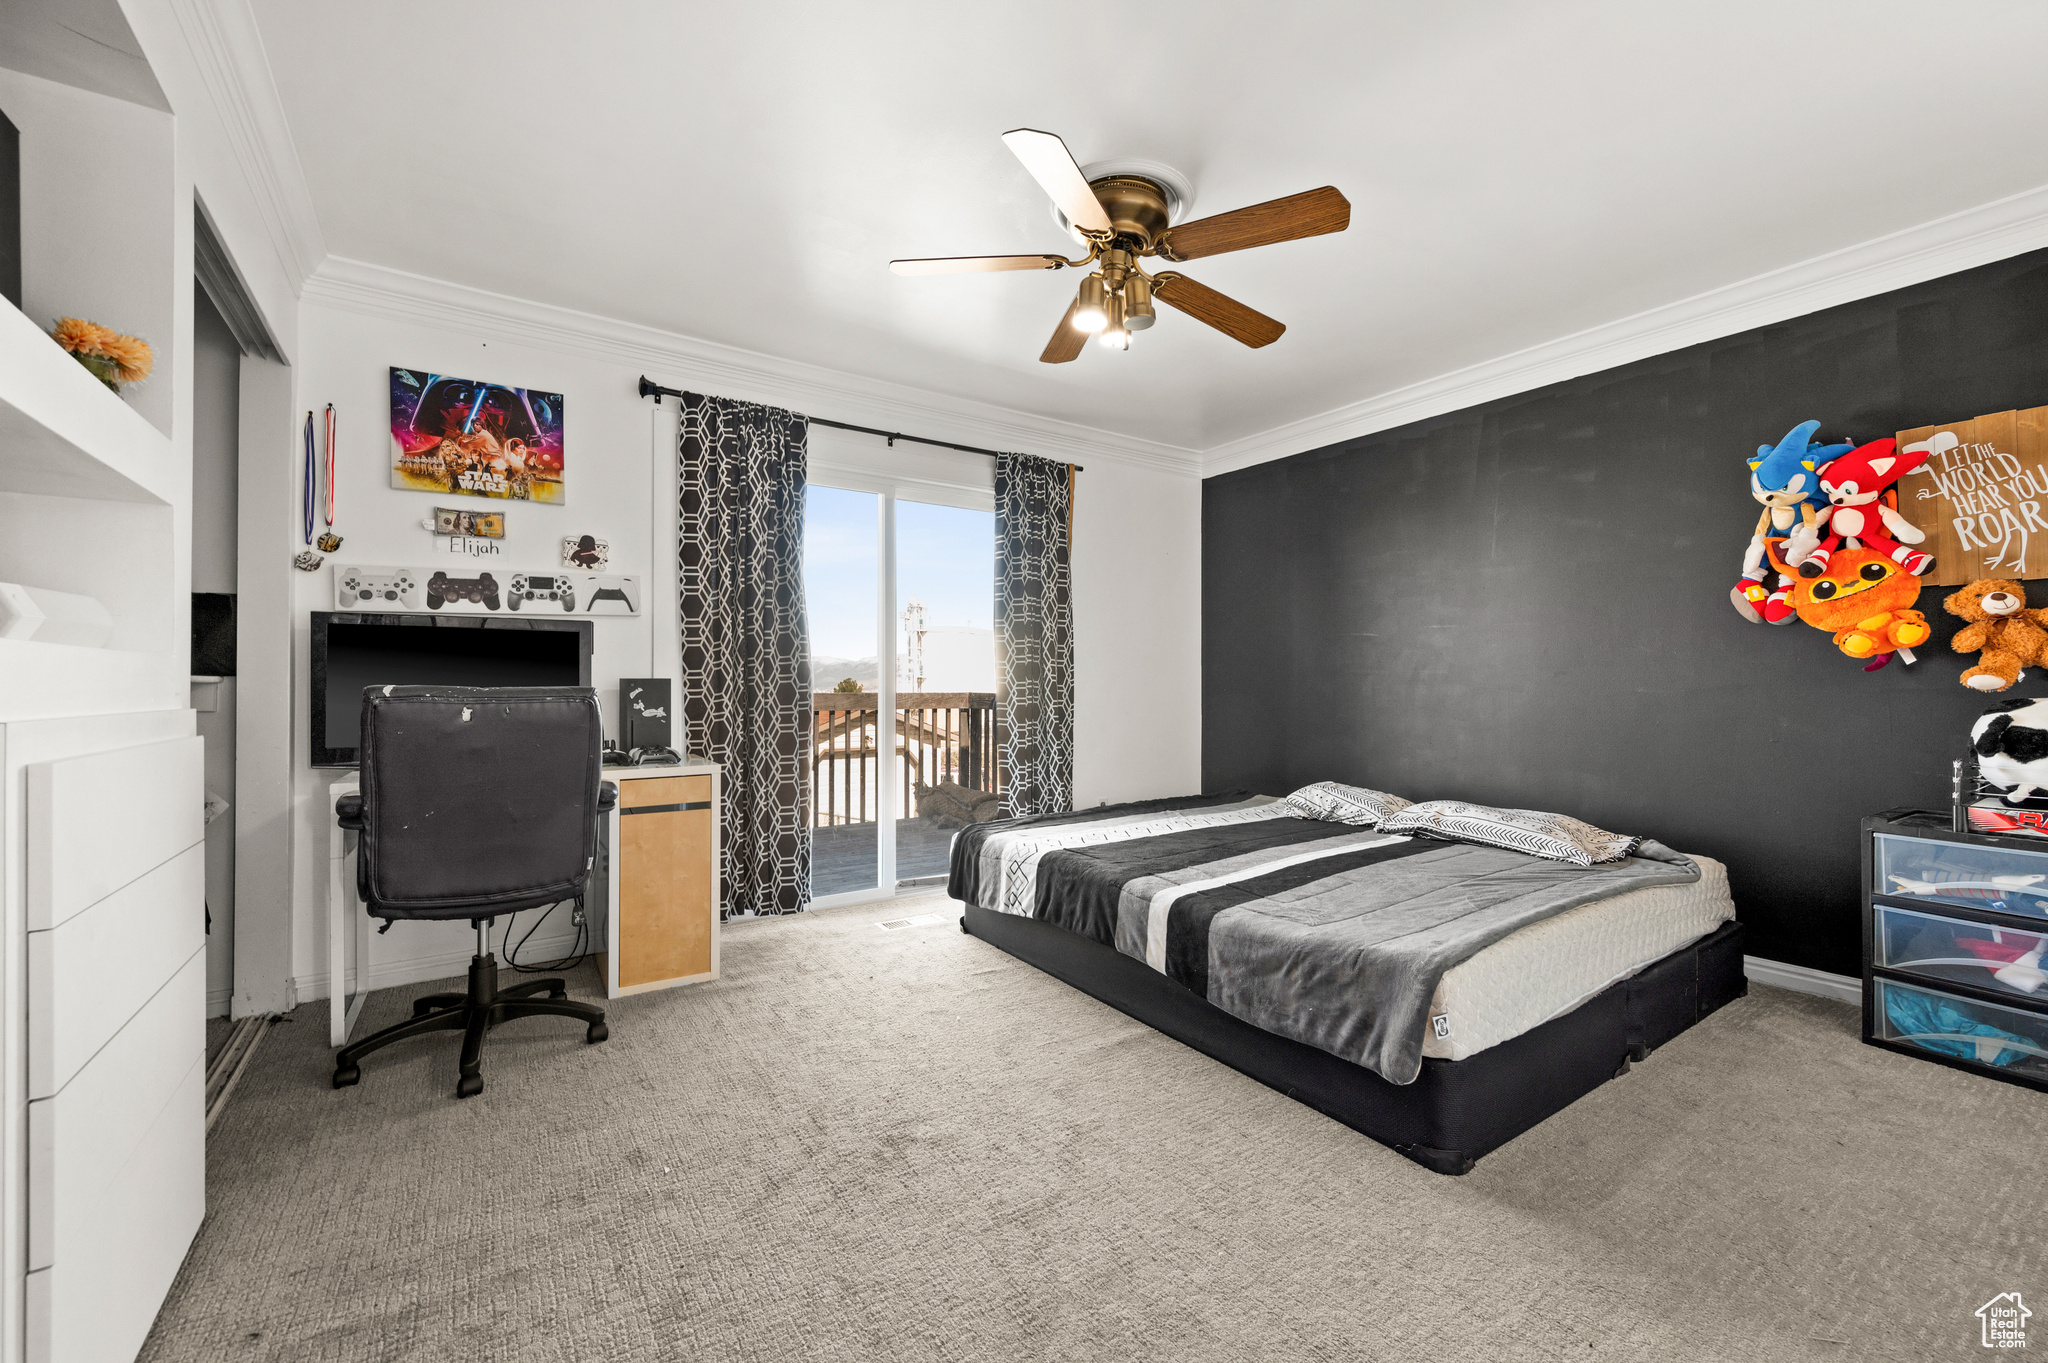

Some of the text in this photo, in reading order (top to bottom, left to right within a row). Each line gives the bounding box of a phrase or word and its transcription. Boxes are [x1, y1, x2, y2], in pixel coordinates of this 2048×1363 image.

[1941, 442, 1998, 472] LET THE
[458, 470, 508, 484] STAR
[458, 479, 508, 493] WARS
[1936, 453, 2022, 500] WORLD
[1952, 464, 2048, 517] HEAR YOU
[1952, 501, 2048, 552] ROAR
[450, 536, 499, 557] Elijah
